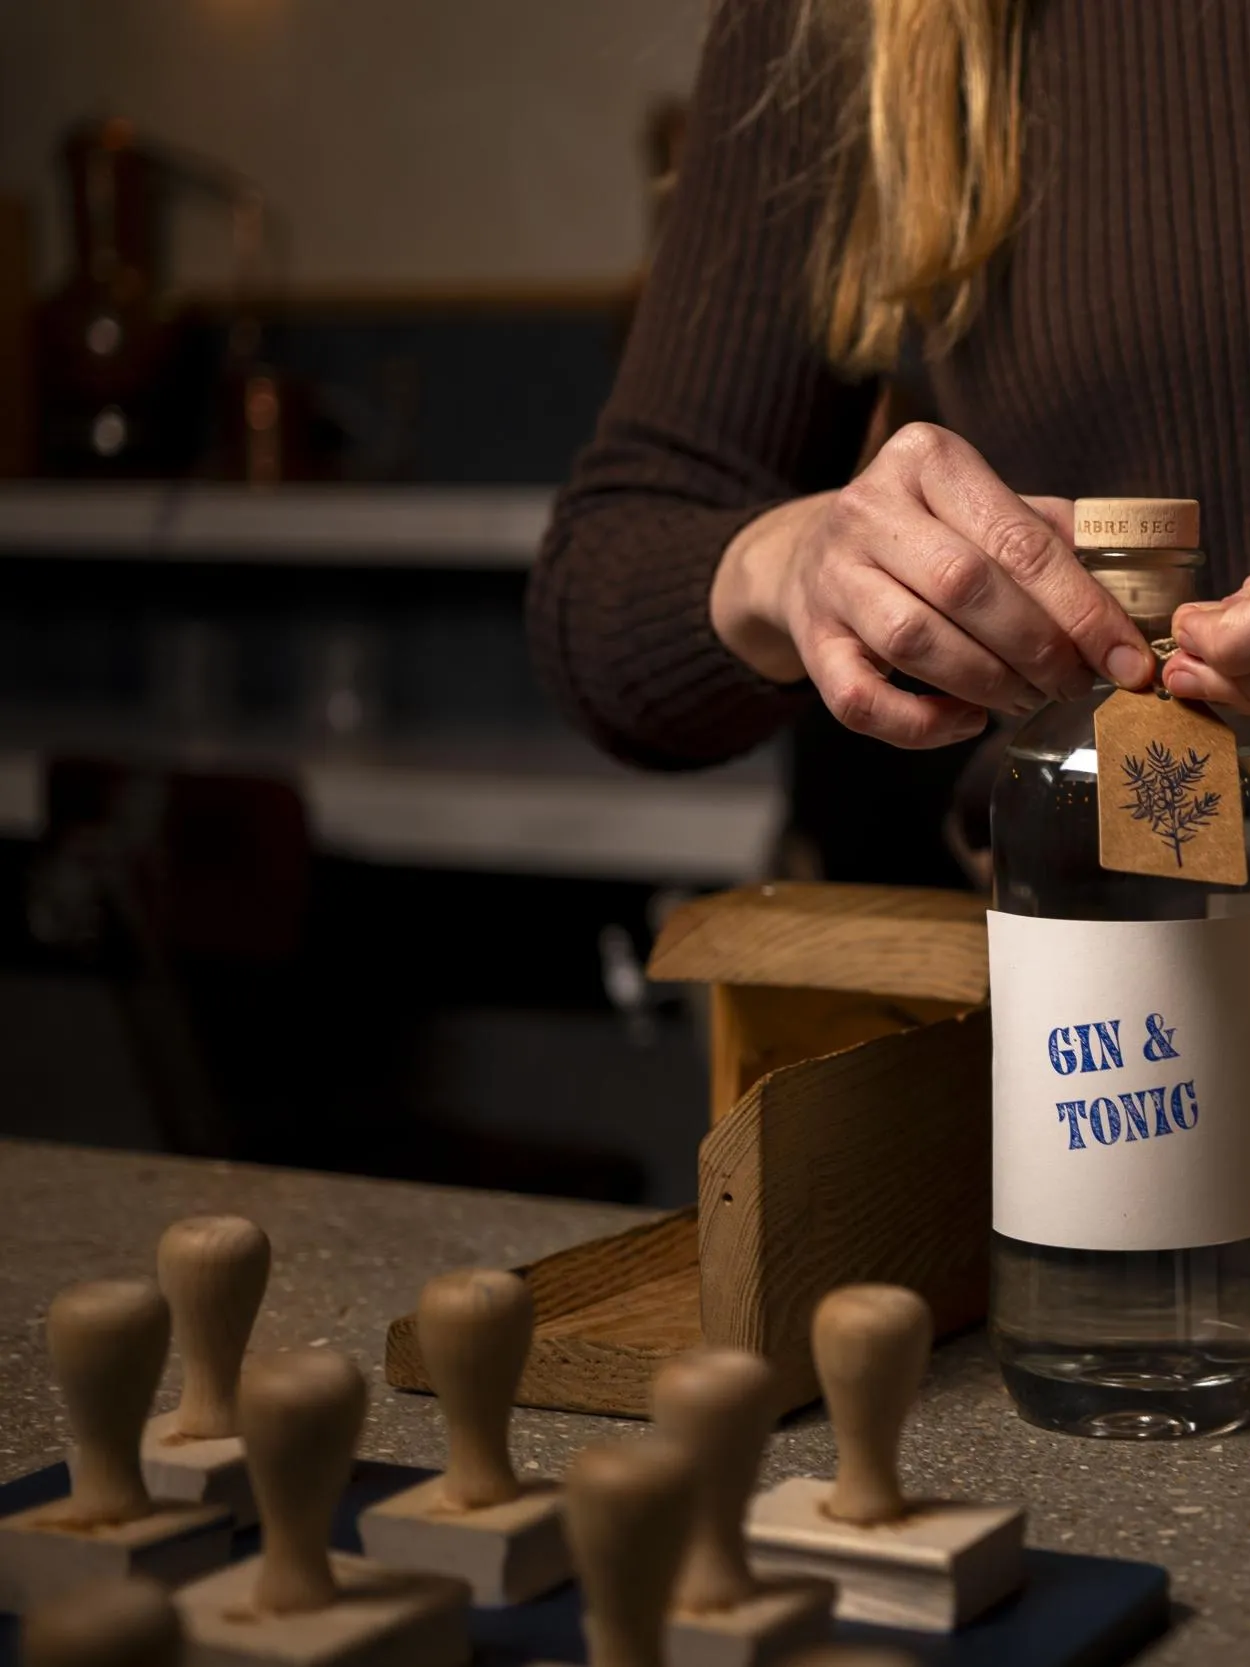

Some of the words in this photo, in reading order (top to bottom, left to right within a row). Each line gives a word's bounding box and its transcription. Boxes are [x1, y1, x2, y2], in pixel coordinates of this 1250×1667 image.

[1140, 520, 1176, 534] SEC
[1048, 1019, 1125, 1076] GIN
[1143, 1012, 1181, 1062] &
[1055, 1079, 1199, 1150] TONIC
